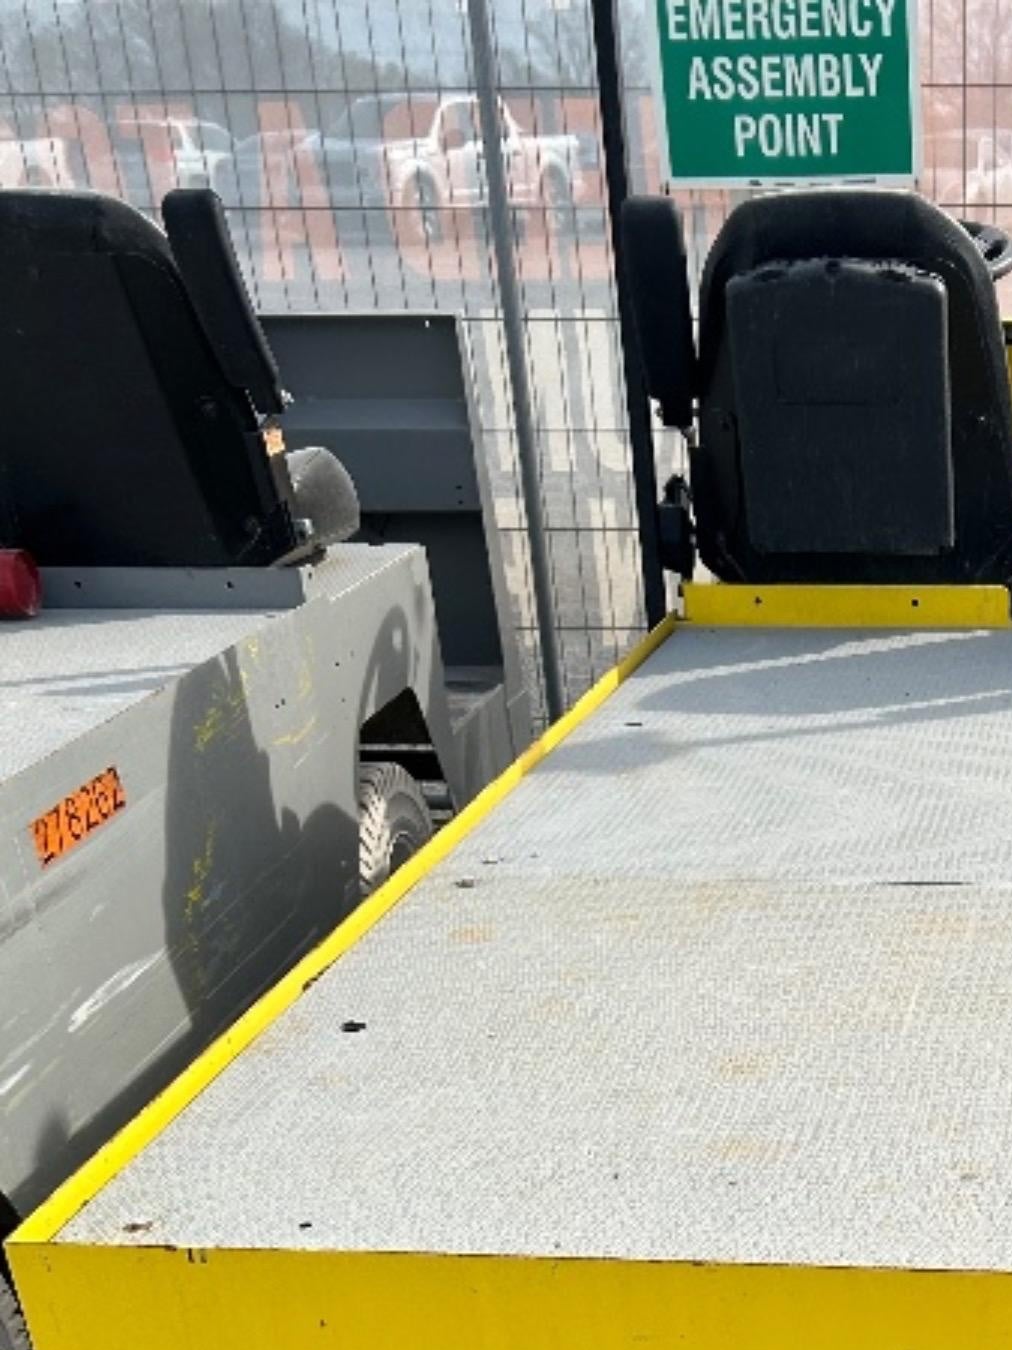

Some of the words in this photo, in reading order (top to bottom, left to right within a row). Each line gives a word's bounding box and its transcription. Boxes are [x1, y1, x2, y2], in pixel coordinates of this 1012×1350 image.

[668, 0, 894, 40] EMERGENCY
[689, 53, 883, 100] ASSEMBLY
[734, 113, 844, 157] POINT
